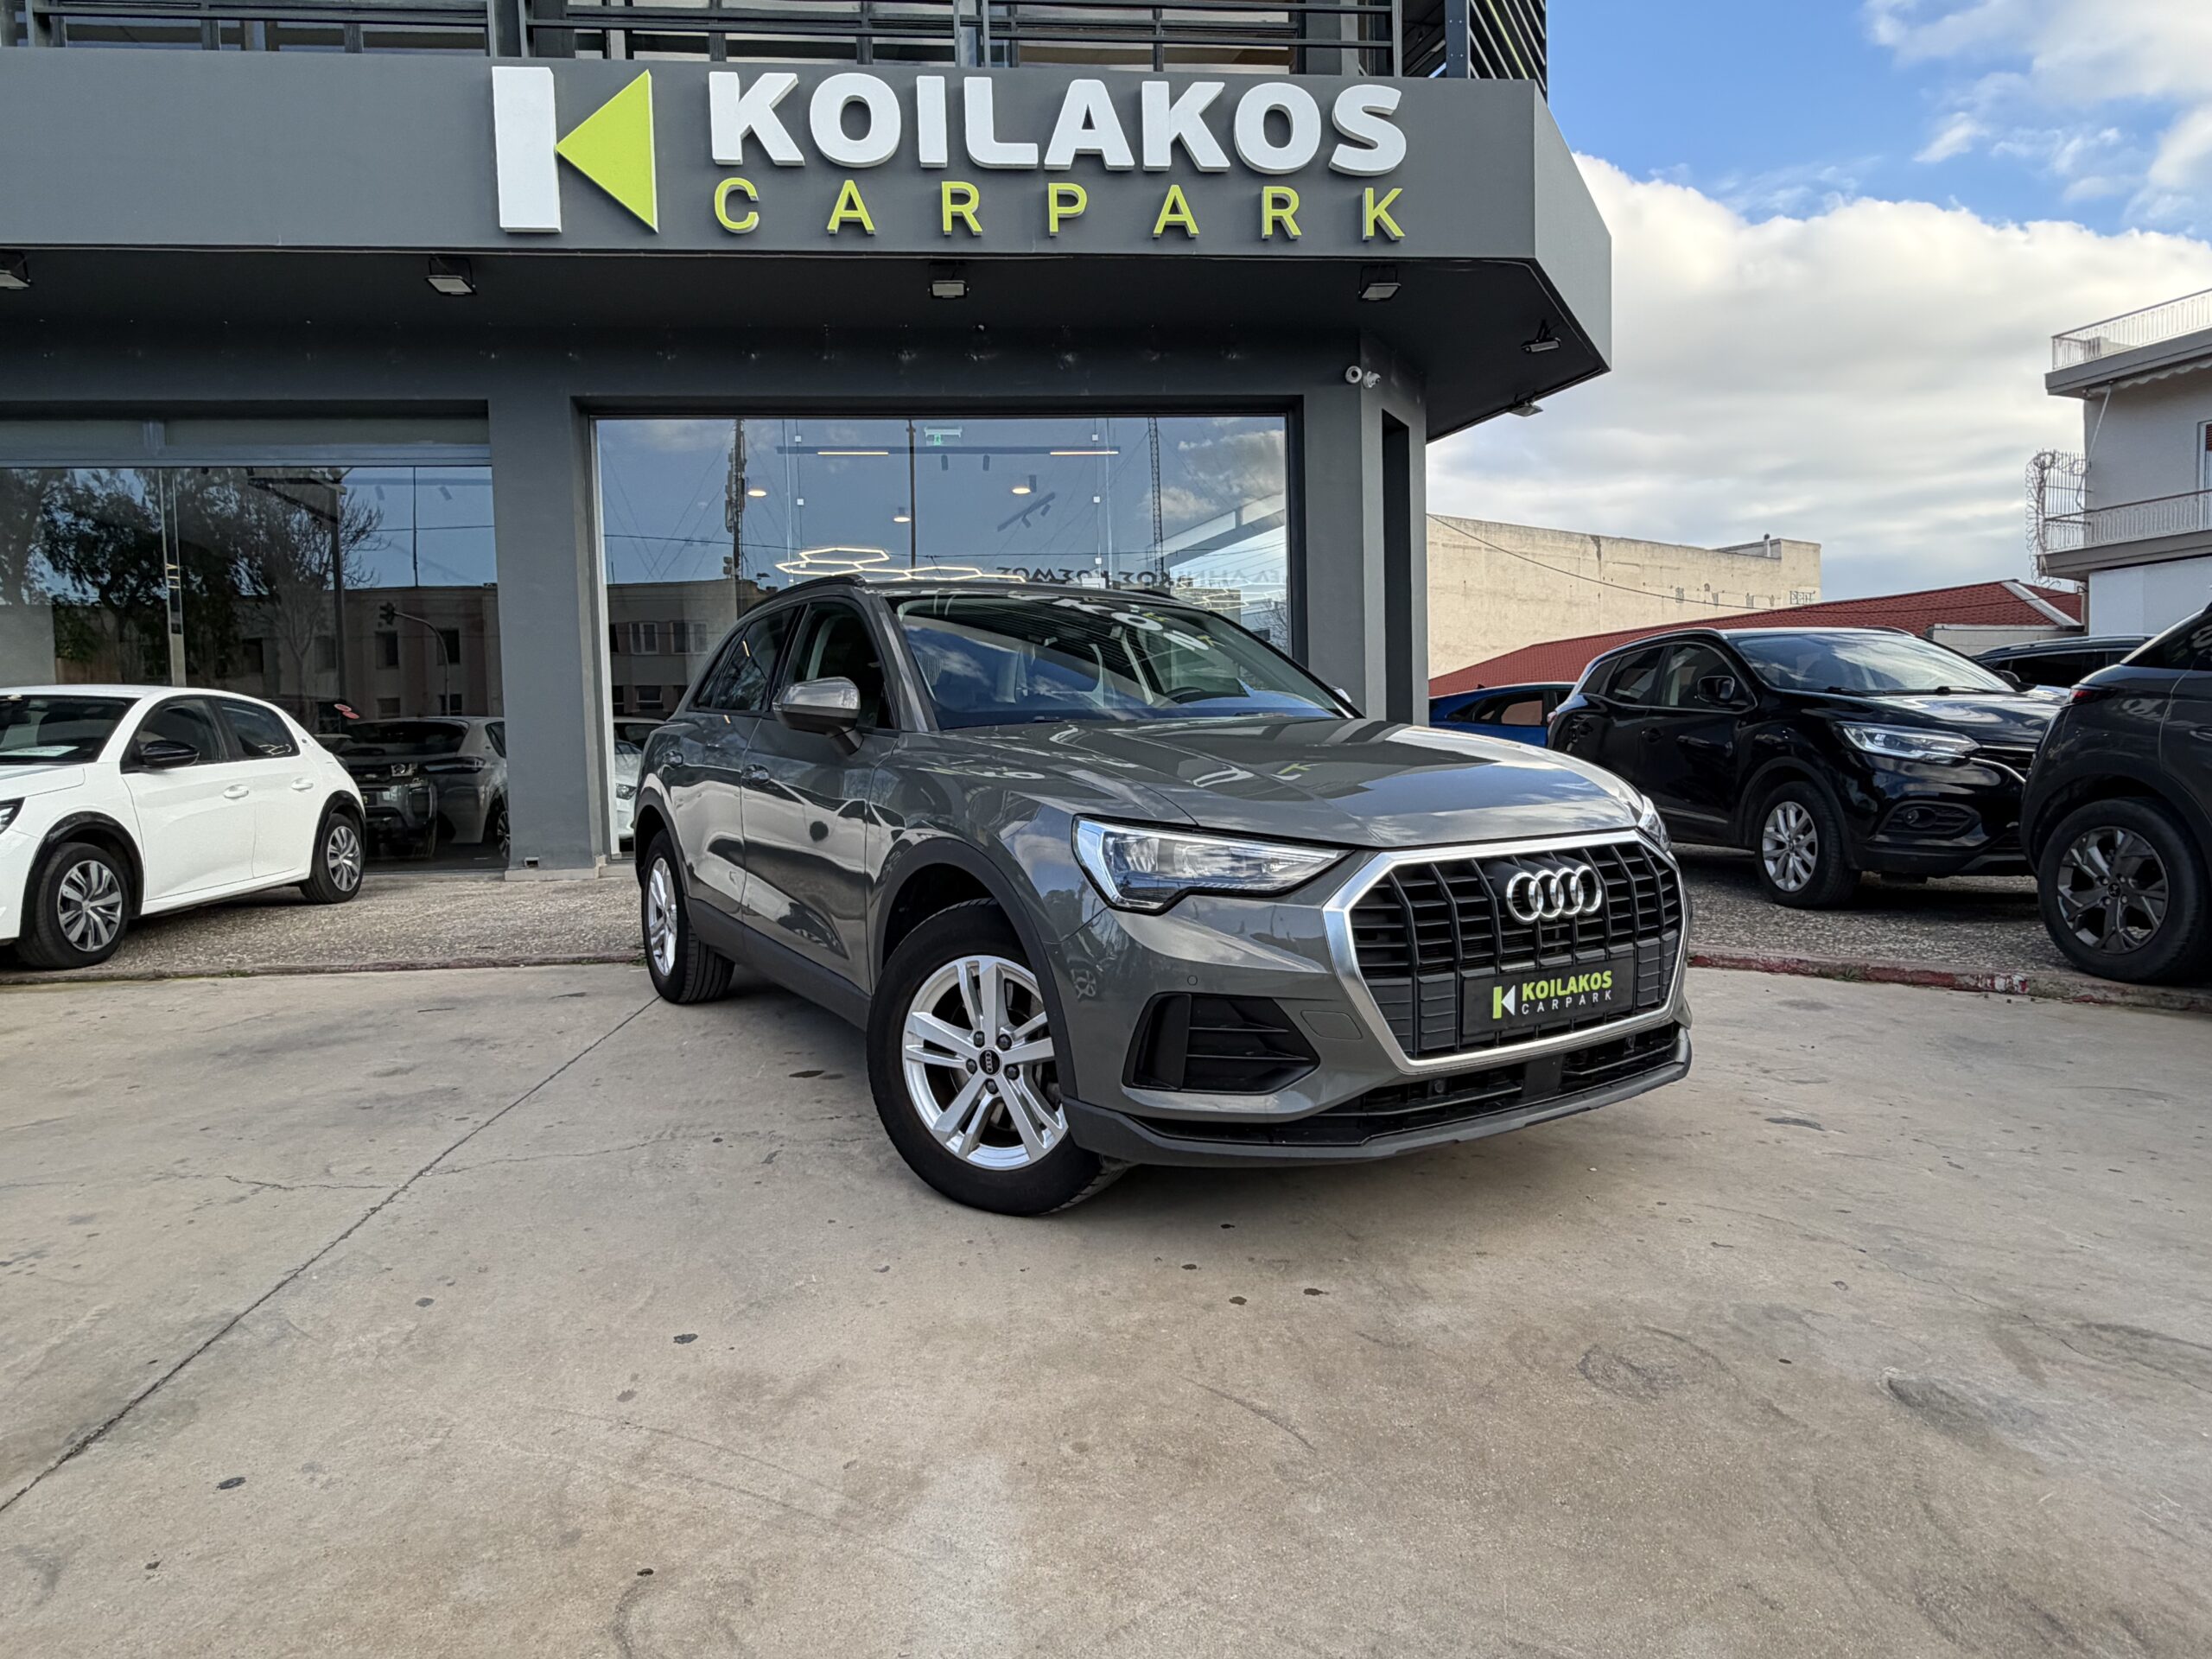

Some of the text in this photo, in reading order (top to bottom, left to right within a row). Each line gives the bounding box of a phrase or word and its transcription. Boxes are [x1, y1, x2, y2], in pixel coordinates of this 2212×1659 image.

[709, 71, 1407, 176] KOILAKOS
[714, 177, 1405, 241] CARPARK
[1522, 970, 1613, 1002] KOILAKOS
[1522, 989, 1612, 1015] CARPARK
